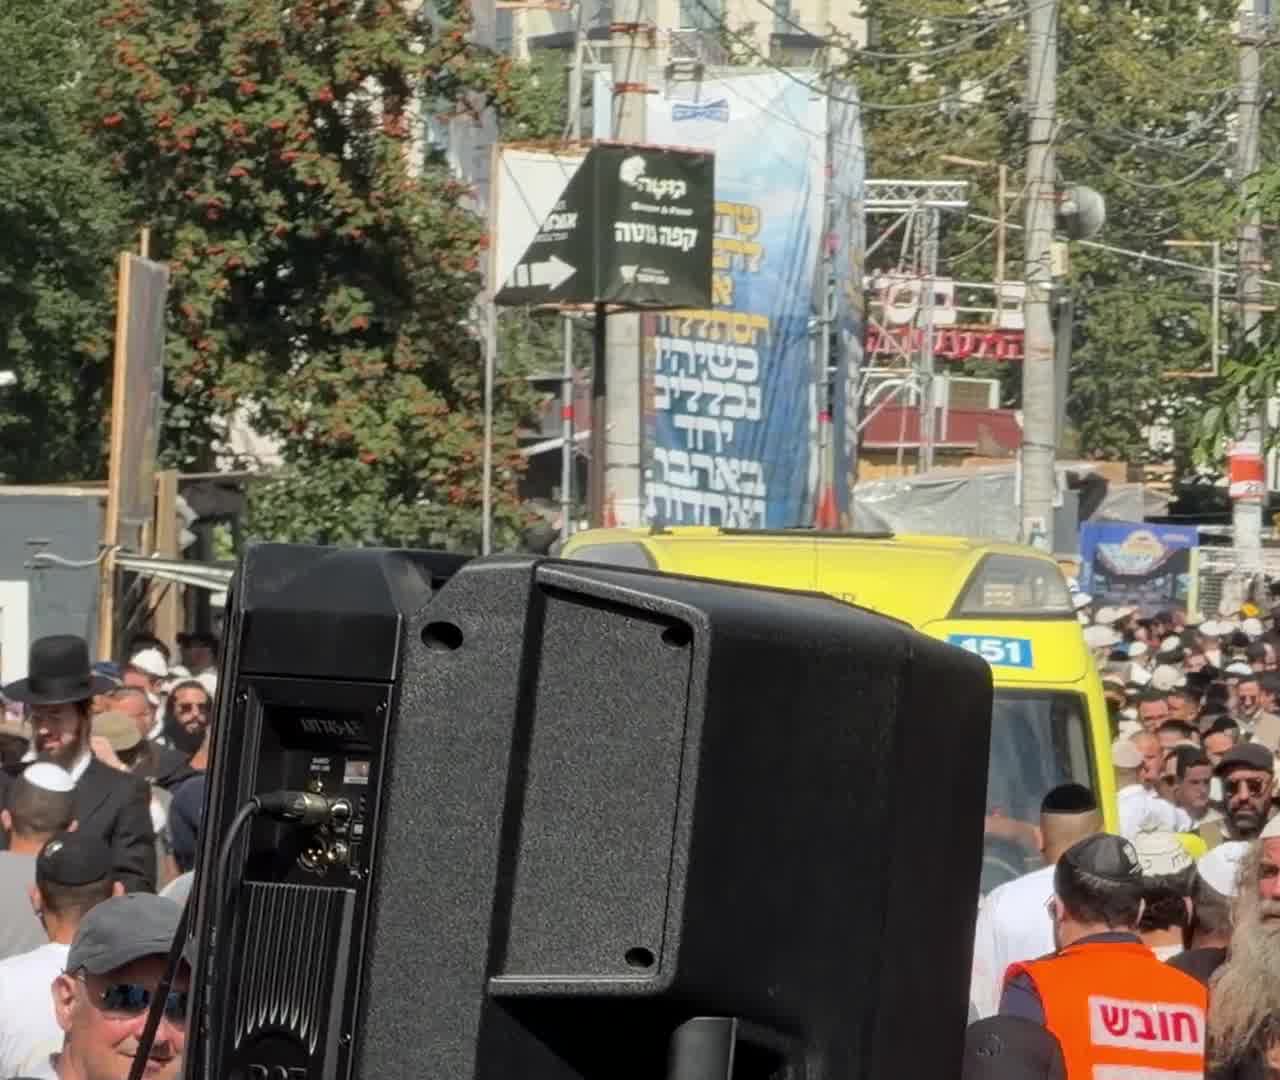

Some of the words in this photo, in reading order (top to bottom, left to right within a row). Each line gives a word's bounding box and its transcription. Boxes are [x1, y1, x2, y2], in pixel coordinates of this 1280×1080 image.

[653, 370, 761, 422] נכללים
[673, 413, 734, 453] יחד
[644, 447, 767, 497] באהבה
[1100, 1003, 1198, 1044] חובש
